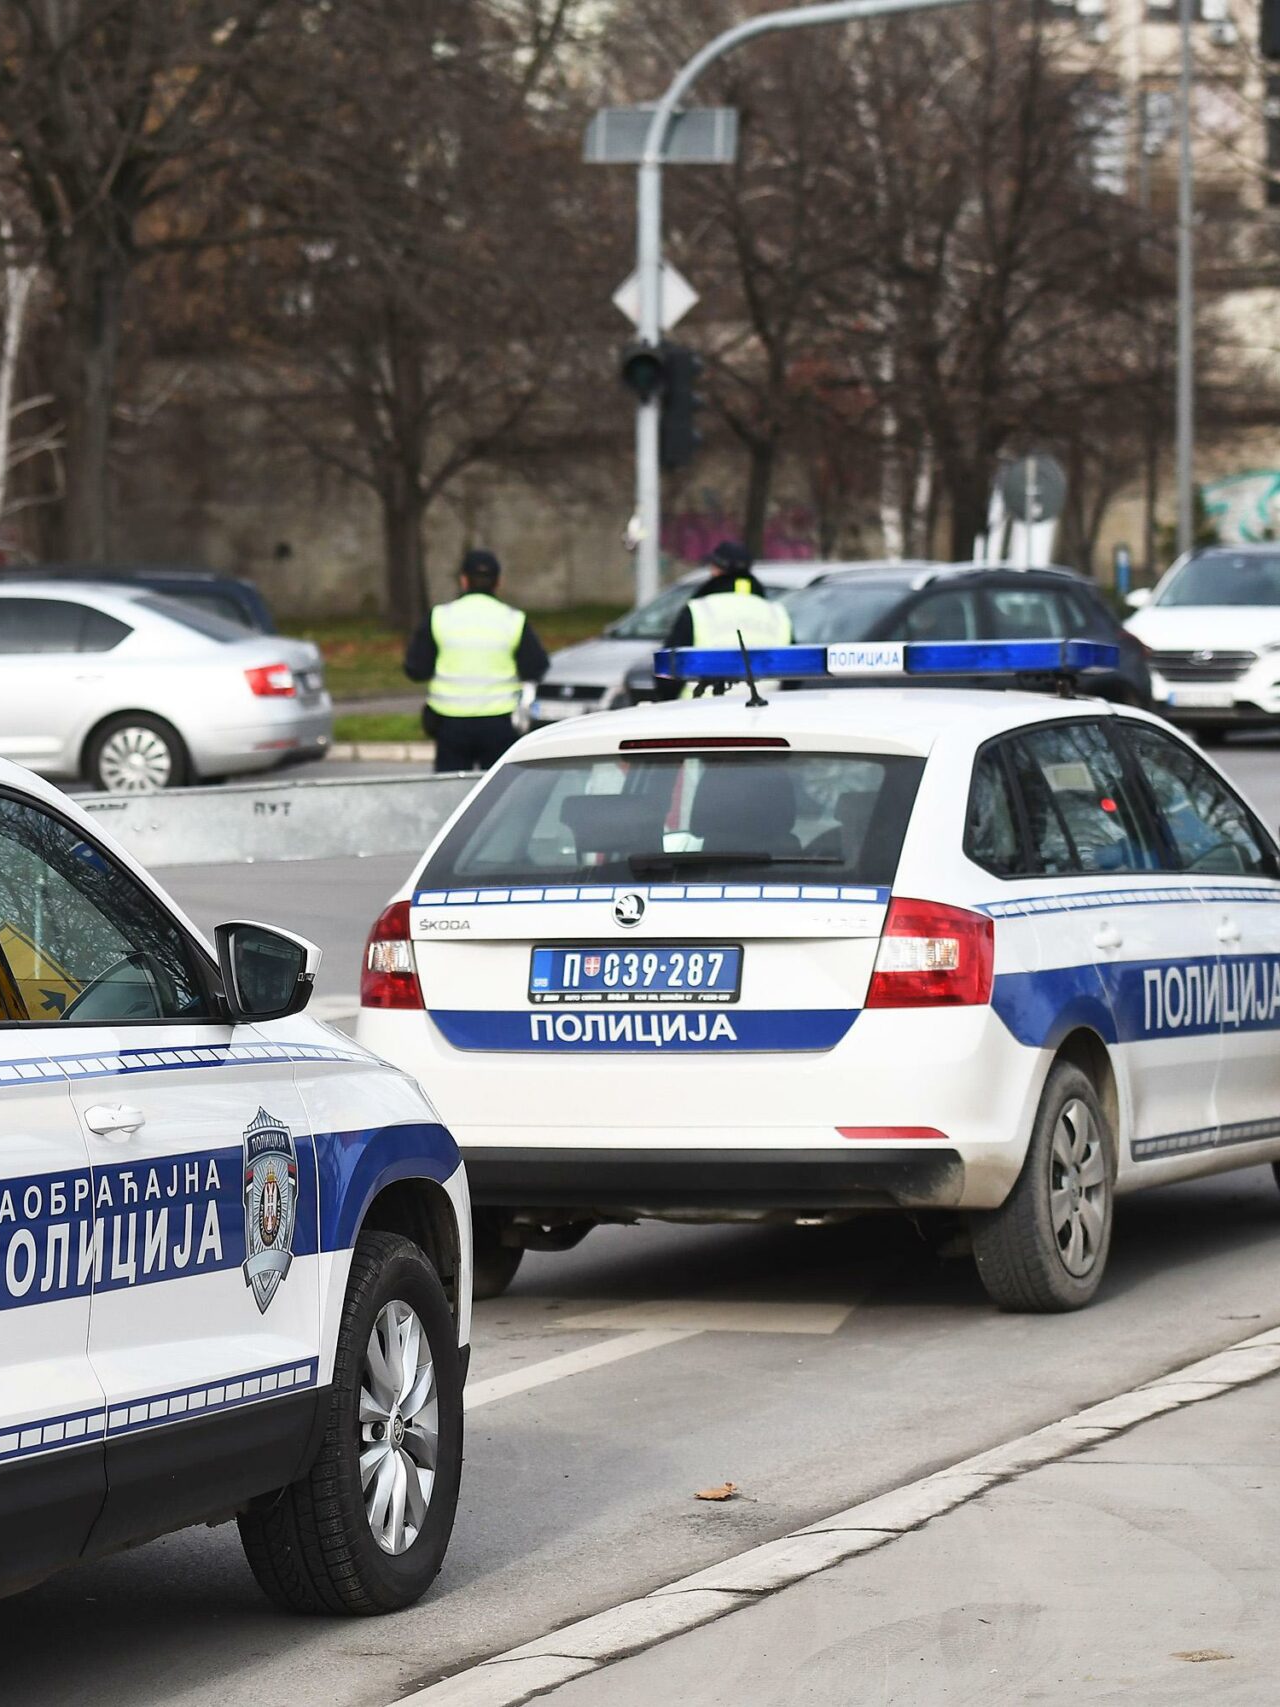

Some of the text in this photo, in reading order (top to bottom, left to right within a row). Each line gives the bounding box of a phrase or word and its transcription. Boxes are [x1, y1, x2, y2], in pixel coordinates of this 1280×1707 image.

[829, 652, 899, 666] ПОЛИЦИЈА
[254, 801, 292, 816] ПУТ
[419, 918, 471, 931] ŠKODA
[563, 953, 581, 987] П
[530, 1014, 738, 1047] ПОЛИЦИЈА
